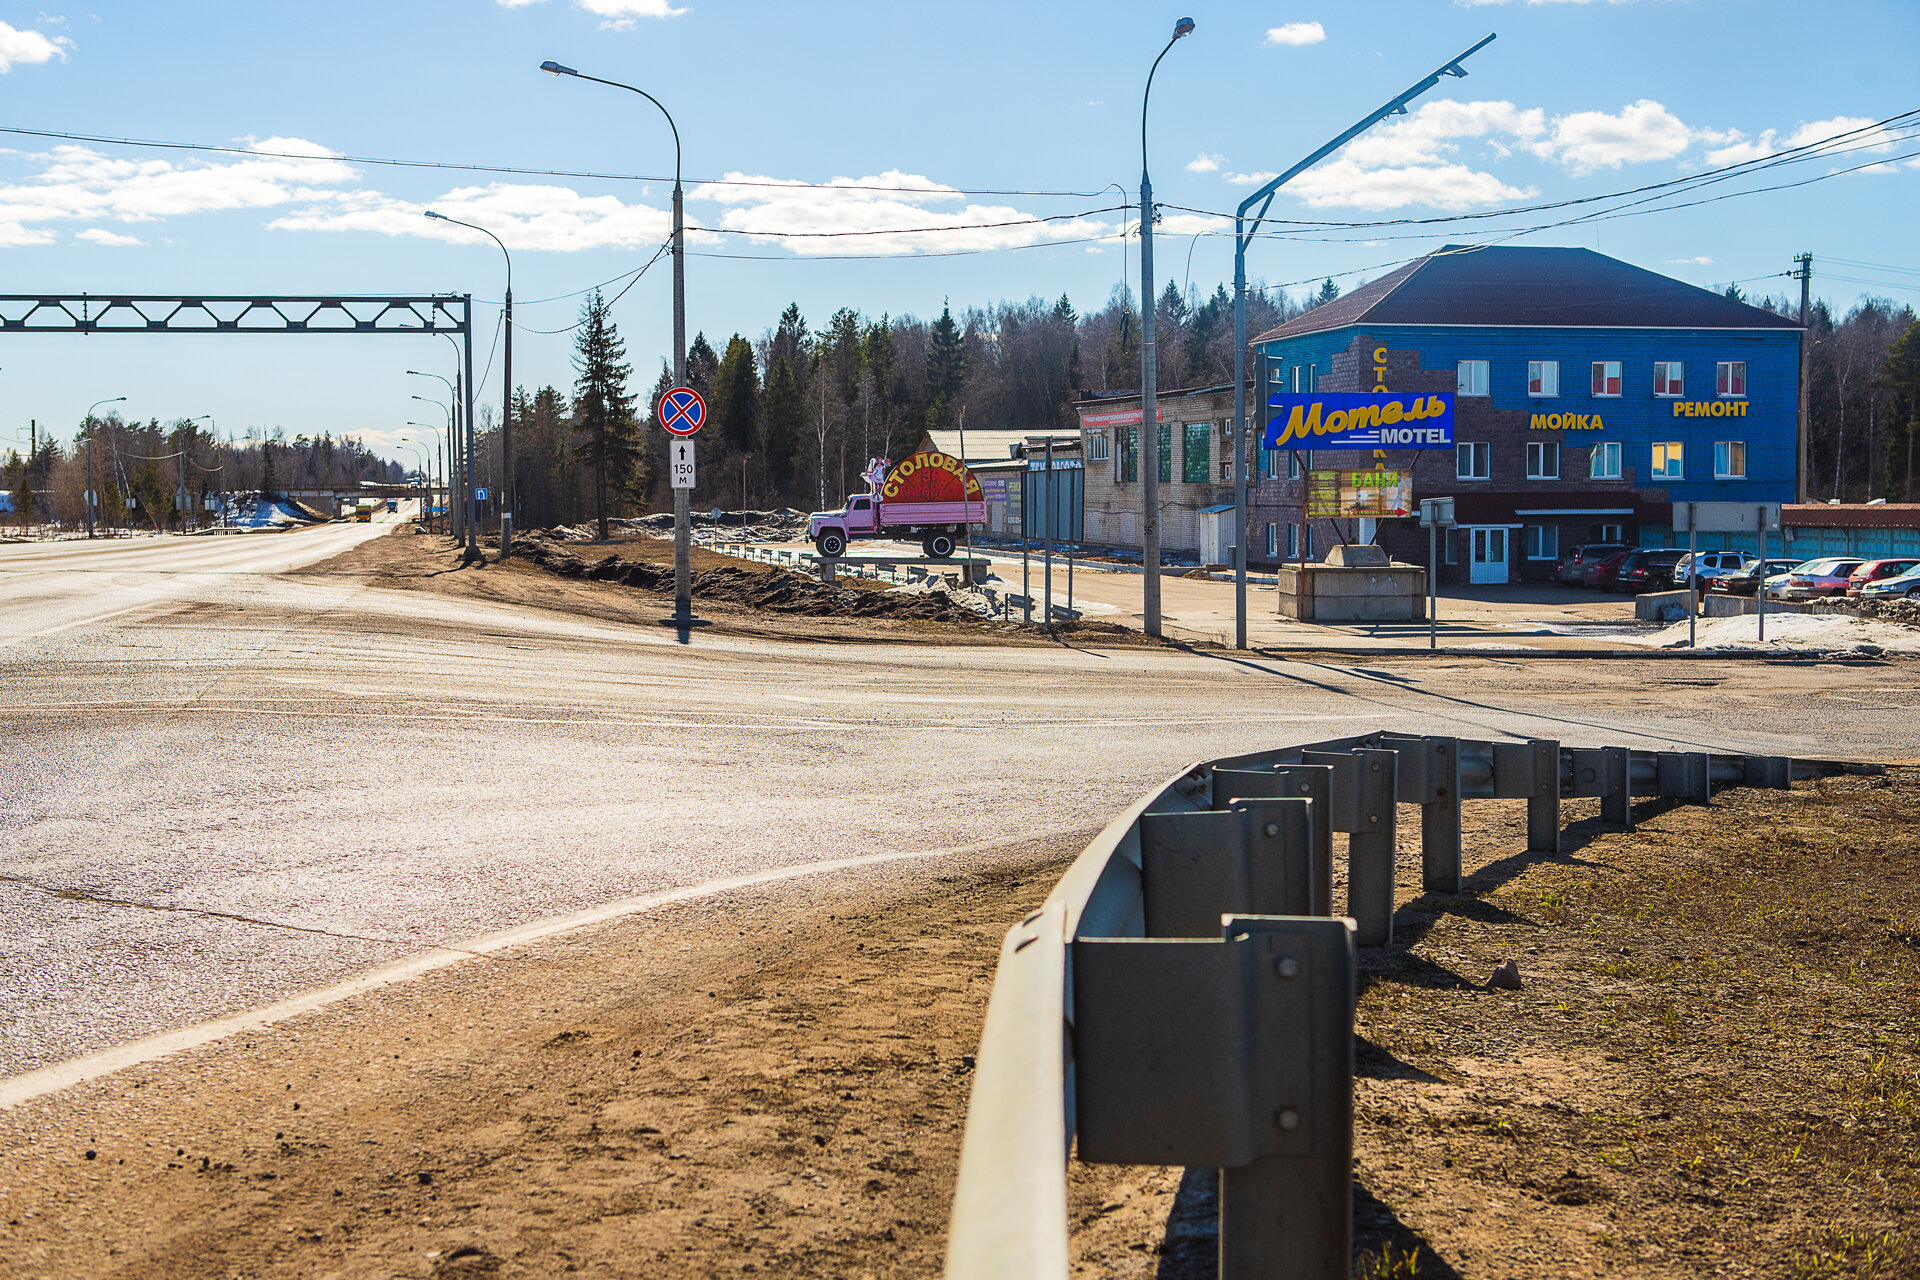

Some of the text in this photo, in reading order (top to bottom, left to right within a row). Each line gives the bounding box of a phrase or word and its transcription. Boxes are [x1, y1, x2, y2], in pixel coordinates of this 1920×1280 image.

[1673, 401, 1749, 417] РЕМОНТ
[1276, 395, 1446, 447] Мотель
[1530, 412, 1604, 430] МОЙКА
[1381, 428, 1451, 444] MOTEL
[674, 464, 693, 474] 150
[884, 453, 980, 498] СТОЛОВАЯ
[1351, 472, 1399, 488] БАНЯ
